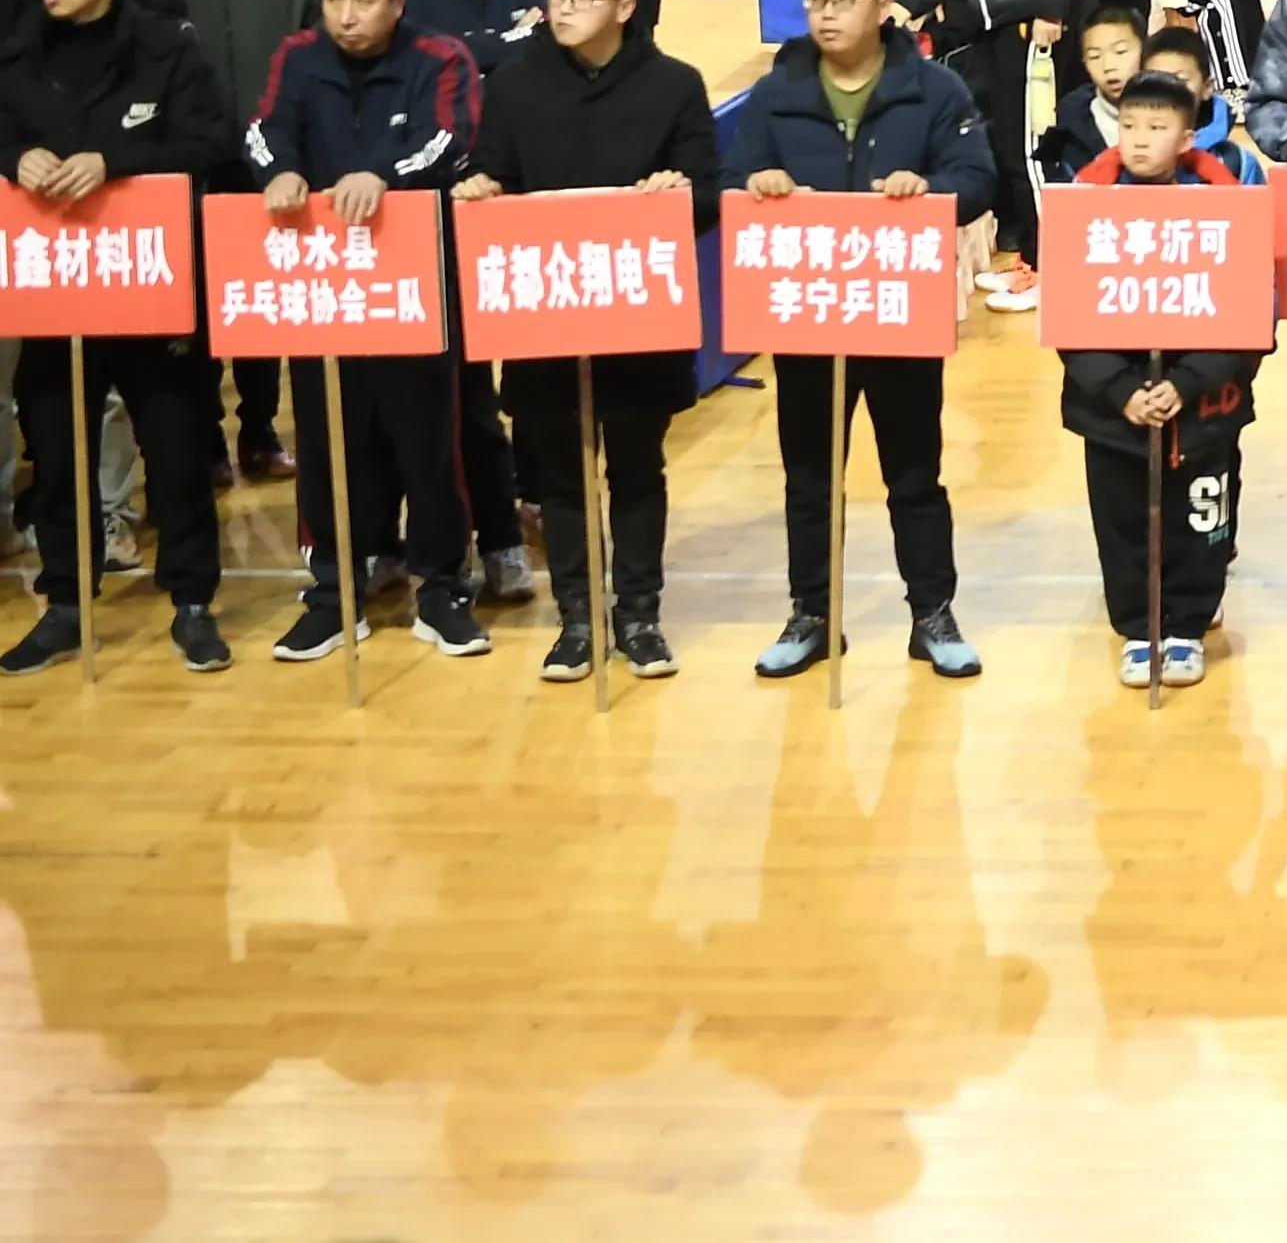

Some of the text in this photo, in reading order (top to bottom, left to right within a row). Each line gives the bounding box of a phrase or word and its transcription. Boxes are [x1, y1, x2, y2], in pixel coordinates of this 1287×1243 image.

[0, 227, 174, 288] 鑫材料队
[265, 226, 378, 271] 邻水县
[735, 224, 941, 271] 成都青少特成
[1085, 218, 1230, 264] 盐亭沂可
[477, 237, 683, 312] 成都众翔电气
[1097, 272, 1216, 316] 2012队
[222, 277, 426, 325] 乒乓球协会二队
[769, 277, 908, 325] 李宁乒团
